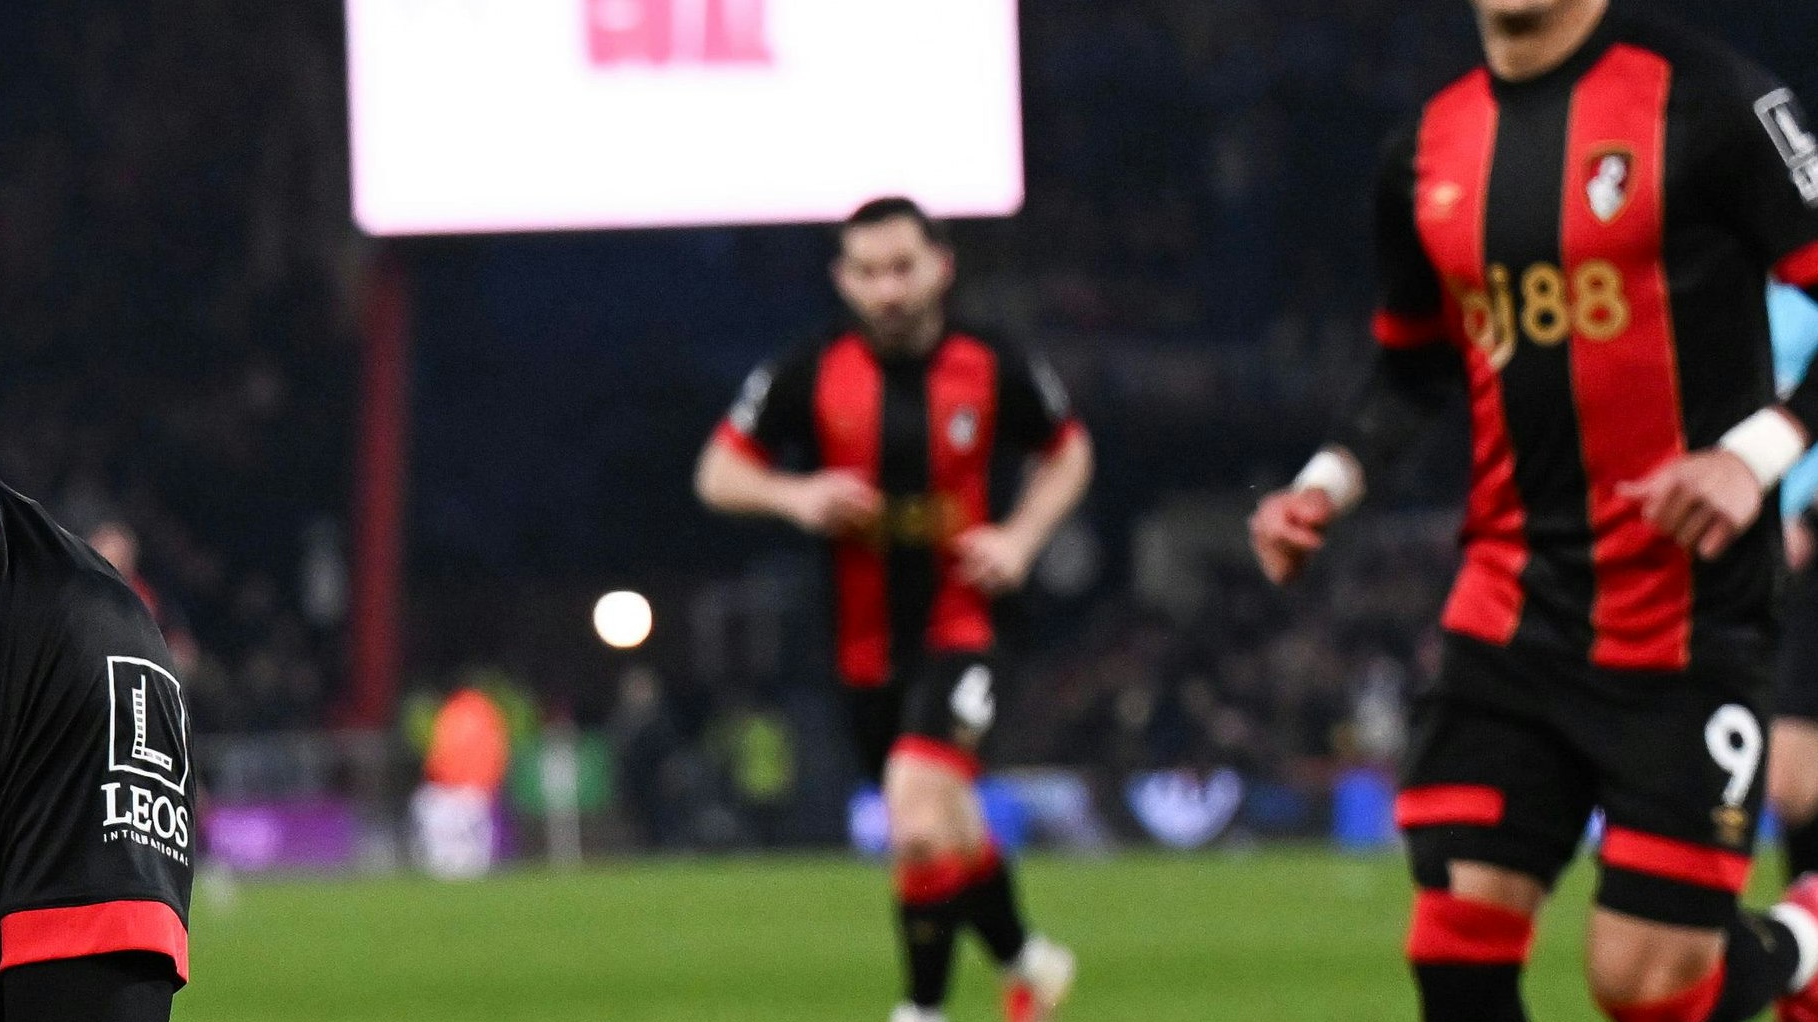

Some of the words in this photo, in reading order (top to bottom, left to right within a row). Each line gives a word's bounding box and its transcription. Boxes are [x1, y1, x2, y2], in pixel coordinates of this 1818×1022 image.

[1704, 702, 1764, 807] 9
[101, 782, 188, 848] LEOS
[103, 830, 189, 867] INTERNATIONAL
